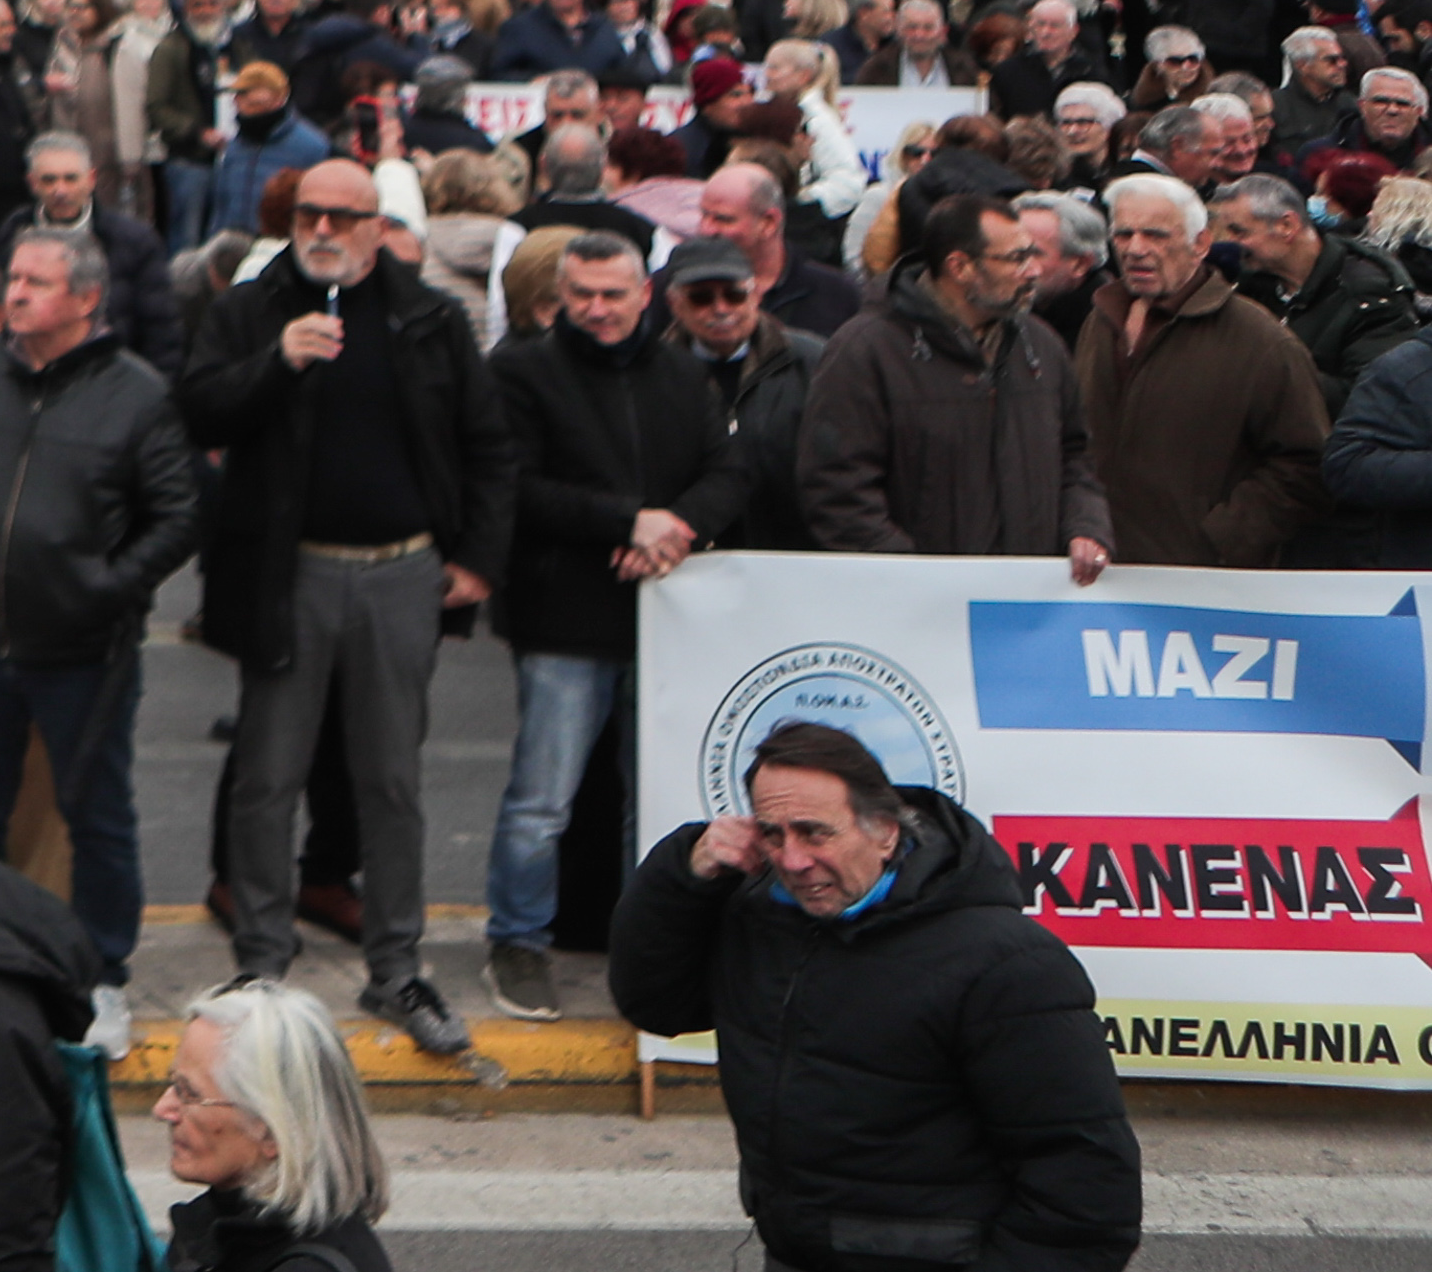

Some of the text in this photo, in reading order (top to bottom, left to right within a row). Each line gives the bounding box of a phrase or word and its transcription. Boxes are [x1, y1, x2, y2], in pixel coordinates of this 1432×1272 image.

[1082, 629, 1299, 701] ΜΑΖΙ
[1017, 842, 1423, 923] ΚΑΝΕΝΑΣ
[1104, 1016, 1402, 1066] ΑΝΕΛΛΗΝΙΑ
